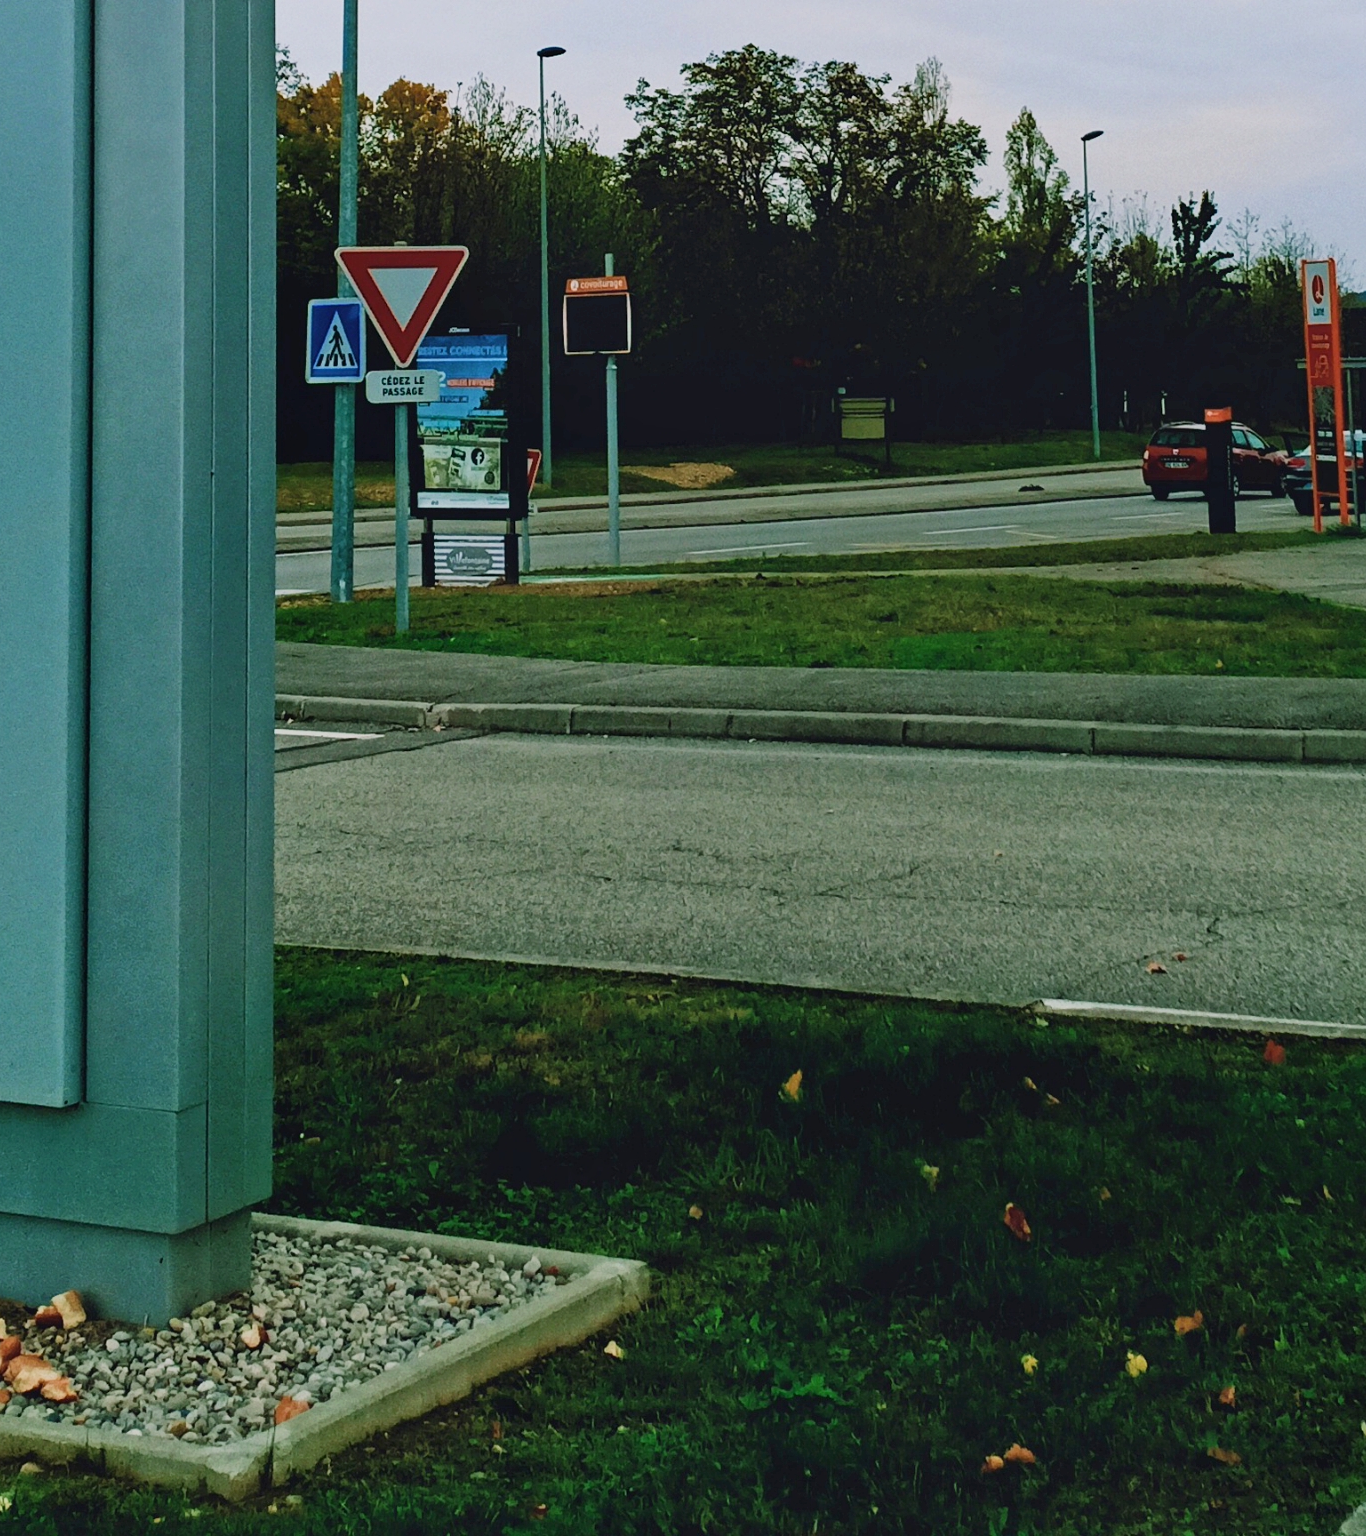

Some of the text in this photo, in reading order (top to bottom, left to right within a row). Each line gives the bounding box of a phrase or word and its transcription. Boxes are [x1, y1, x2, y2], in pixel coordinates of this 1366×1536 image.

[580, 279, 623, 289] covoiturage
[381, 375, 425, 385] CÉDEZ LE
[382, 387, 424, 396] PASSAGE
